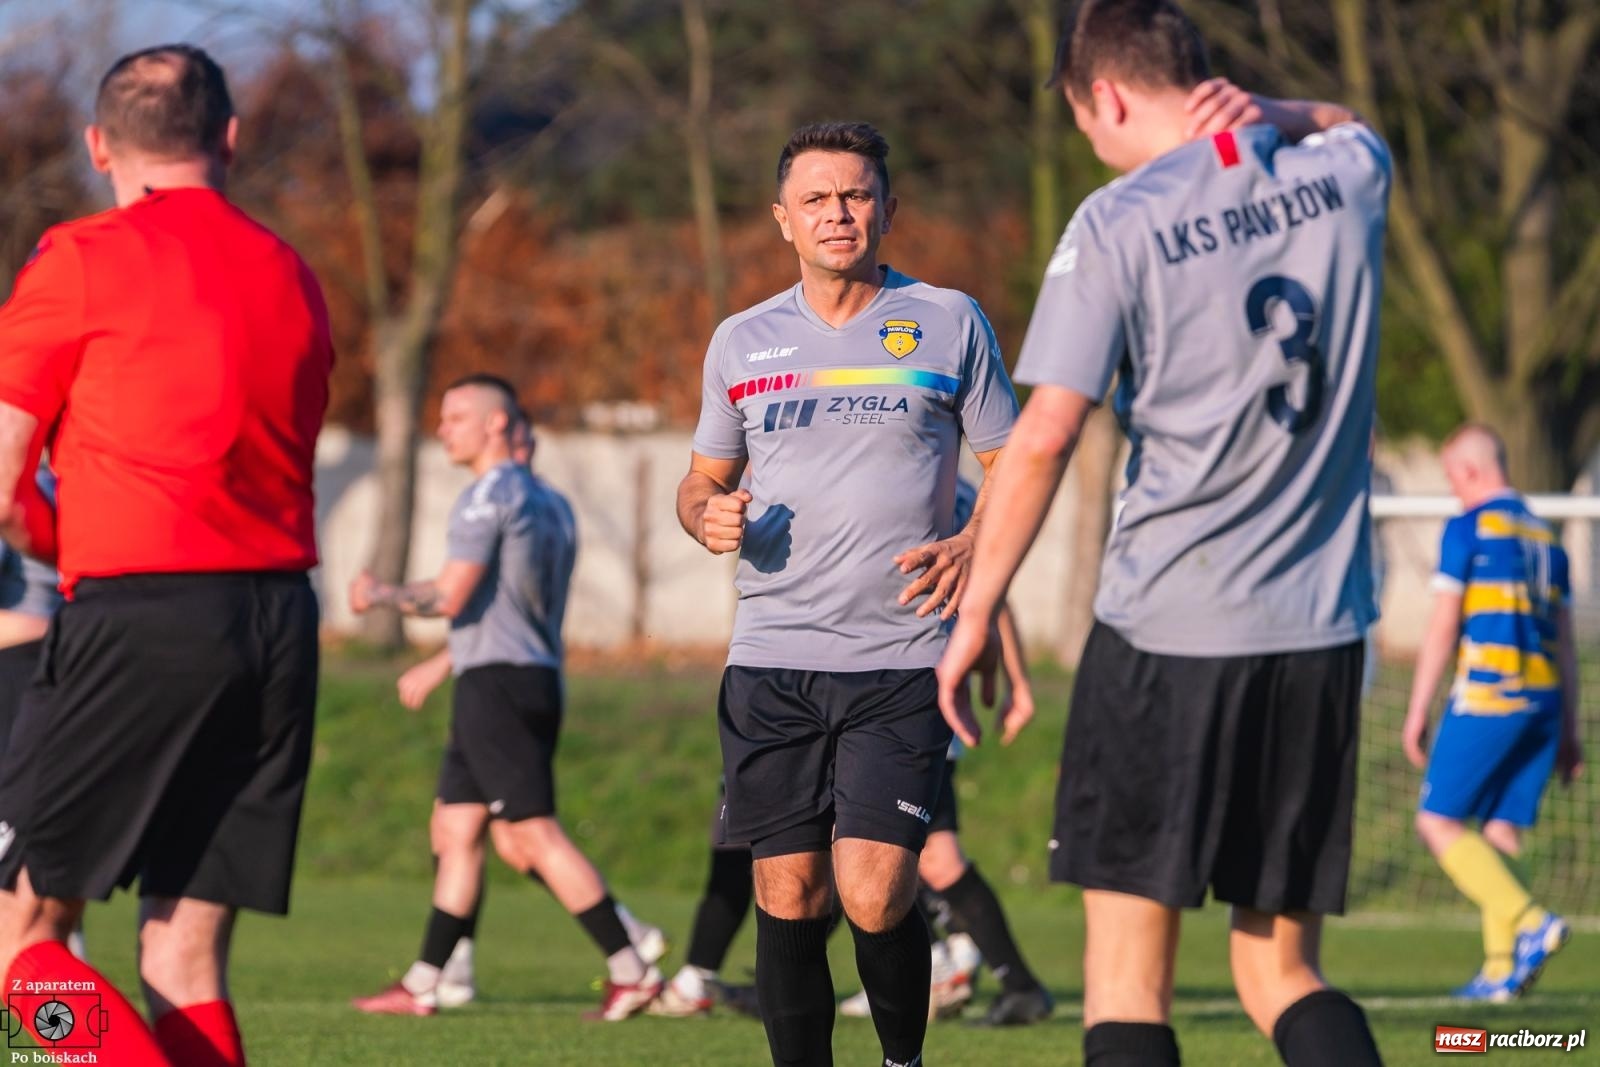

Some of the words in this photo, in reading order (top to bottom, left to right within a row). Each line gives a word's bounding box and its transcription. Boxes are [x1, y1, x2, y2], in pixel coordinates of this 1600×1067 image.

[1154, 216, 1219, 265] LKS
[1245, 275, 1327, 434] 3
[826, 395, 909, 413] ZYGLA
[842, 413, 886, 425] STEEL
